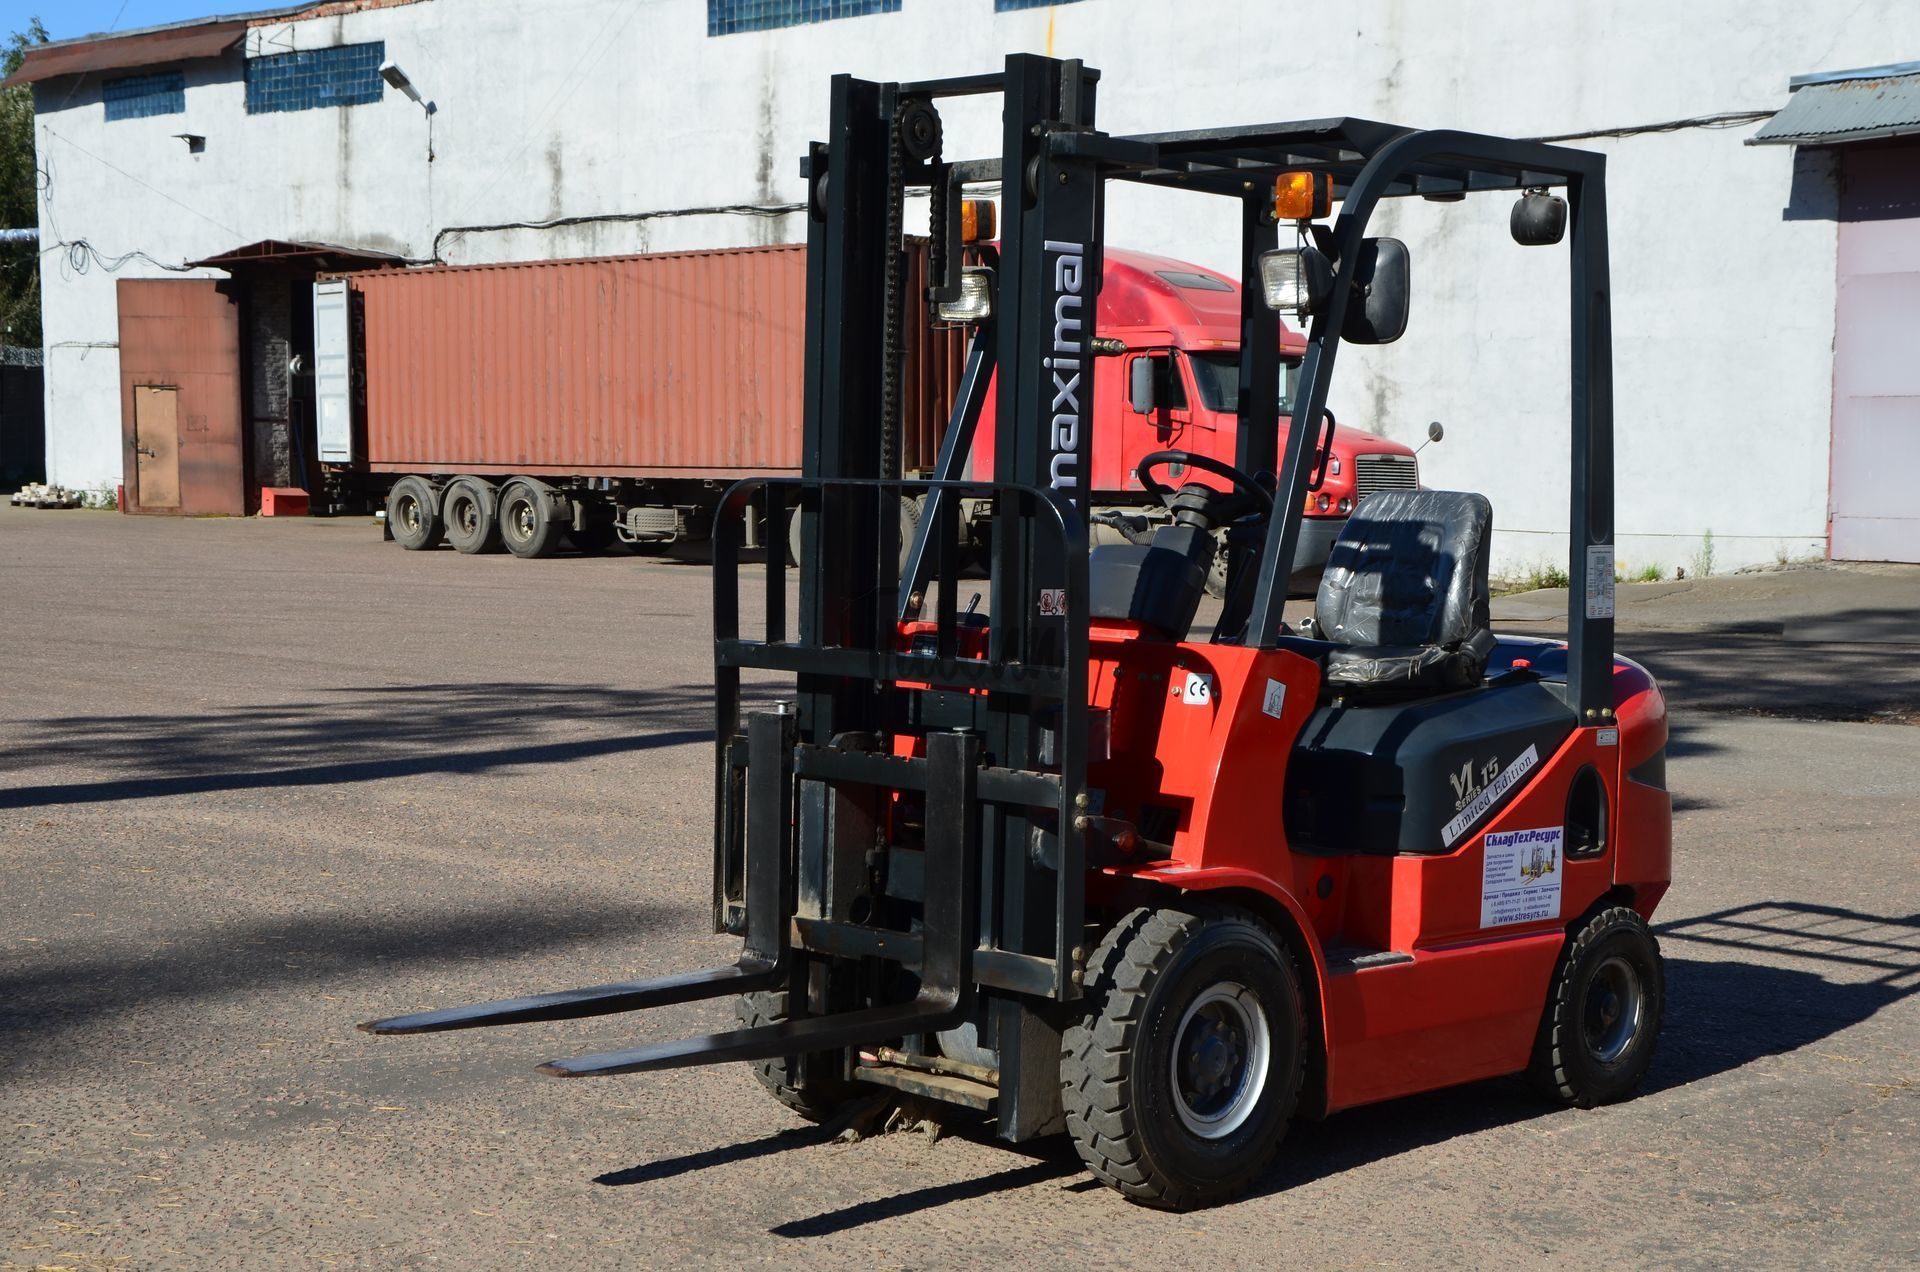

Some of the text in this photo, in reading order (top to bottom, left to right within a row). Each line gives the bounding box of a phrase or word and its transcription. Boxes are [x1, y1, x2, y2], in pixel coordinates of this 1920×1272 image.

[1043, 240, 1084, 508] maximal
[1189, 681, 1208, 697] CE
[1480, 756, 1499, 786] 15
[1448, 756, 1532, 838] Limited Edition
[1455, 785, 1482, 811] SERIES
[1498, 910, 1549, 923] www.stresyrs.ru
